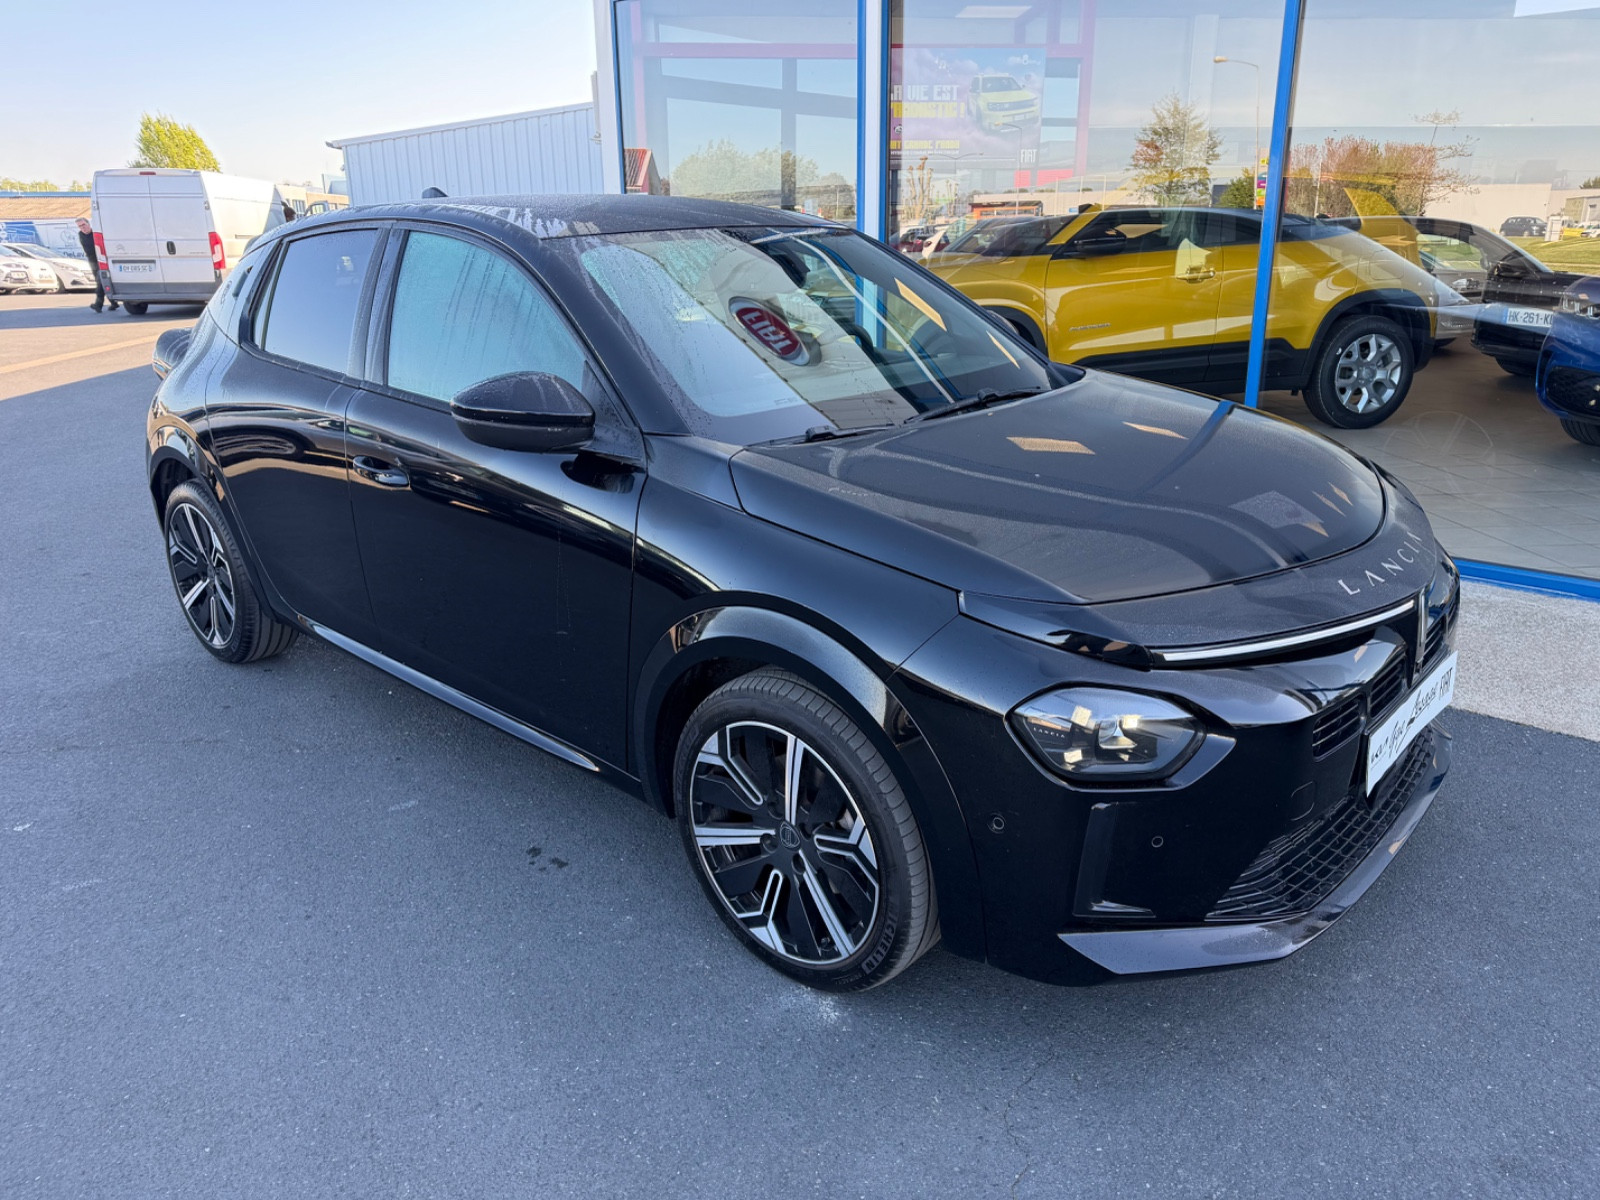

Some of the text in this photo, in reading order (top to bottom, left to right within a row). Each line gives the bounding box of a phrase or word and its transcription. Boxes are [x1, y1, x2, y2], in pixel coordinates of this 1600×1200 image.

[908, 84, 929, 100] VIE
[933, 84, 960, 100] EST
[1020, 148, 1038, 164] FIAT
[1337, 530, 1422, 596] LANCIA
[1033, 727, 1065, 738] LANCIA
